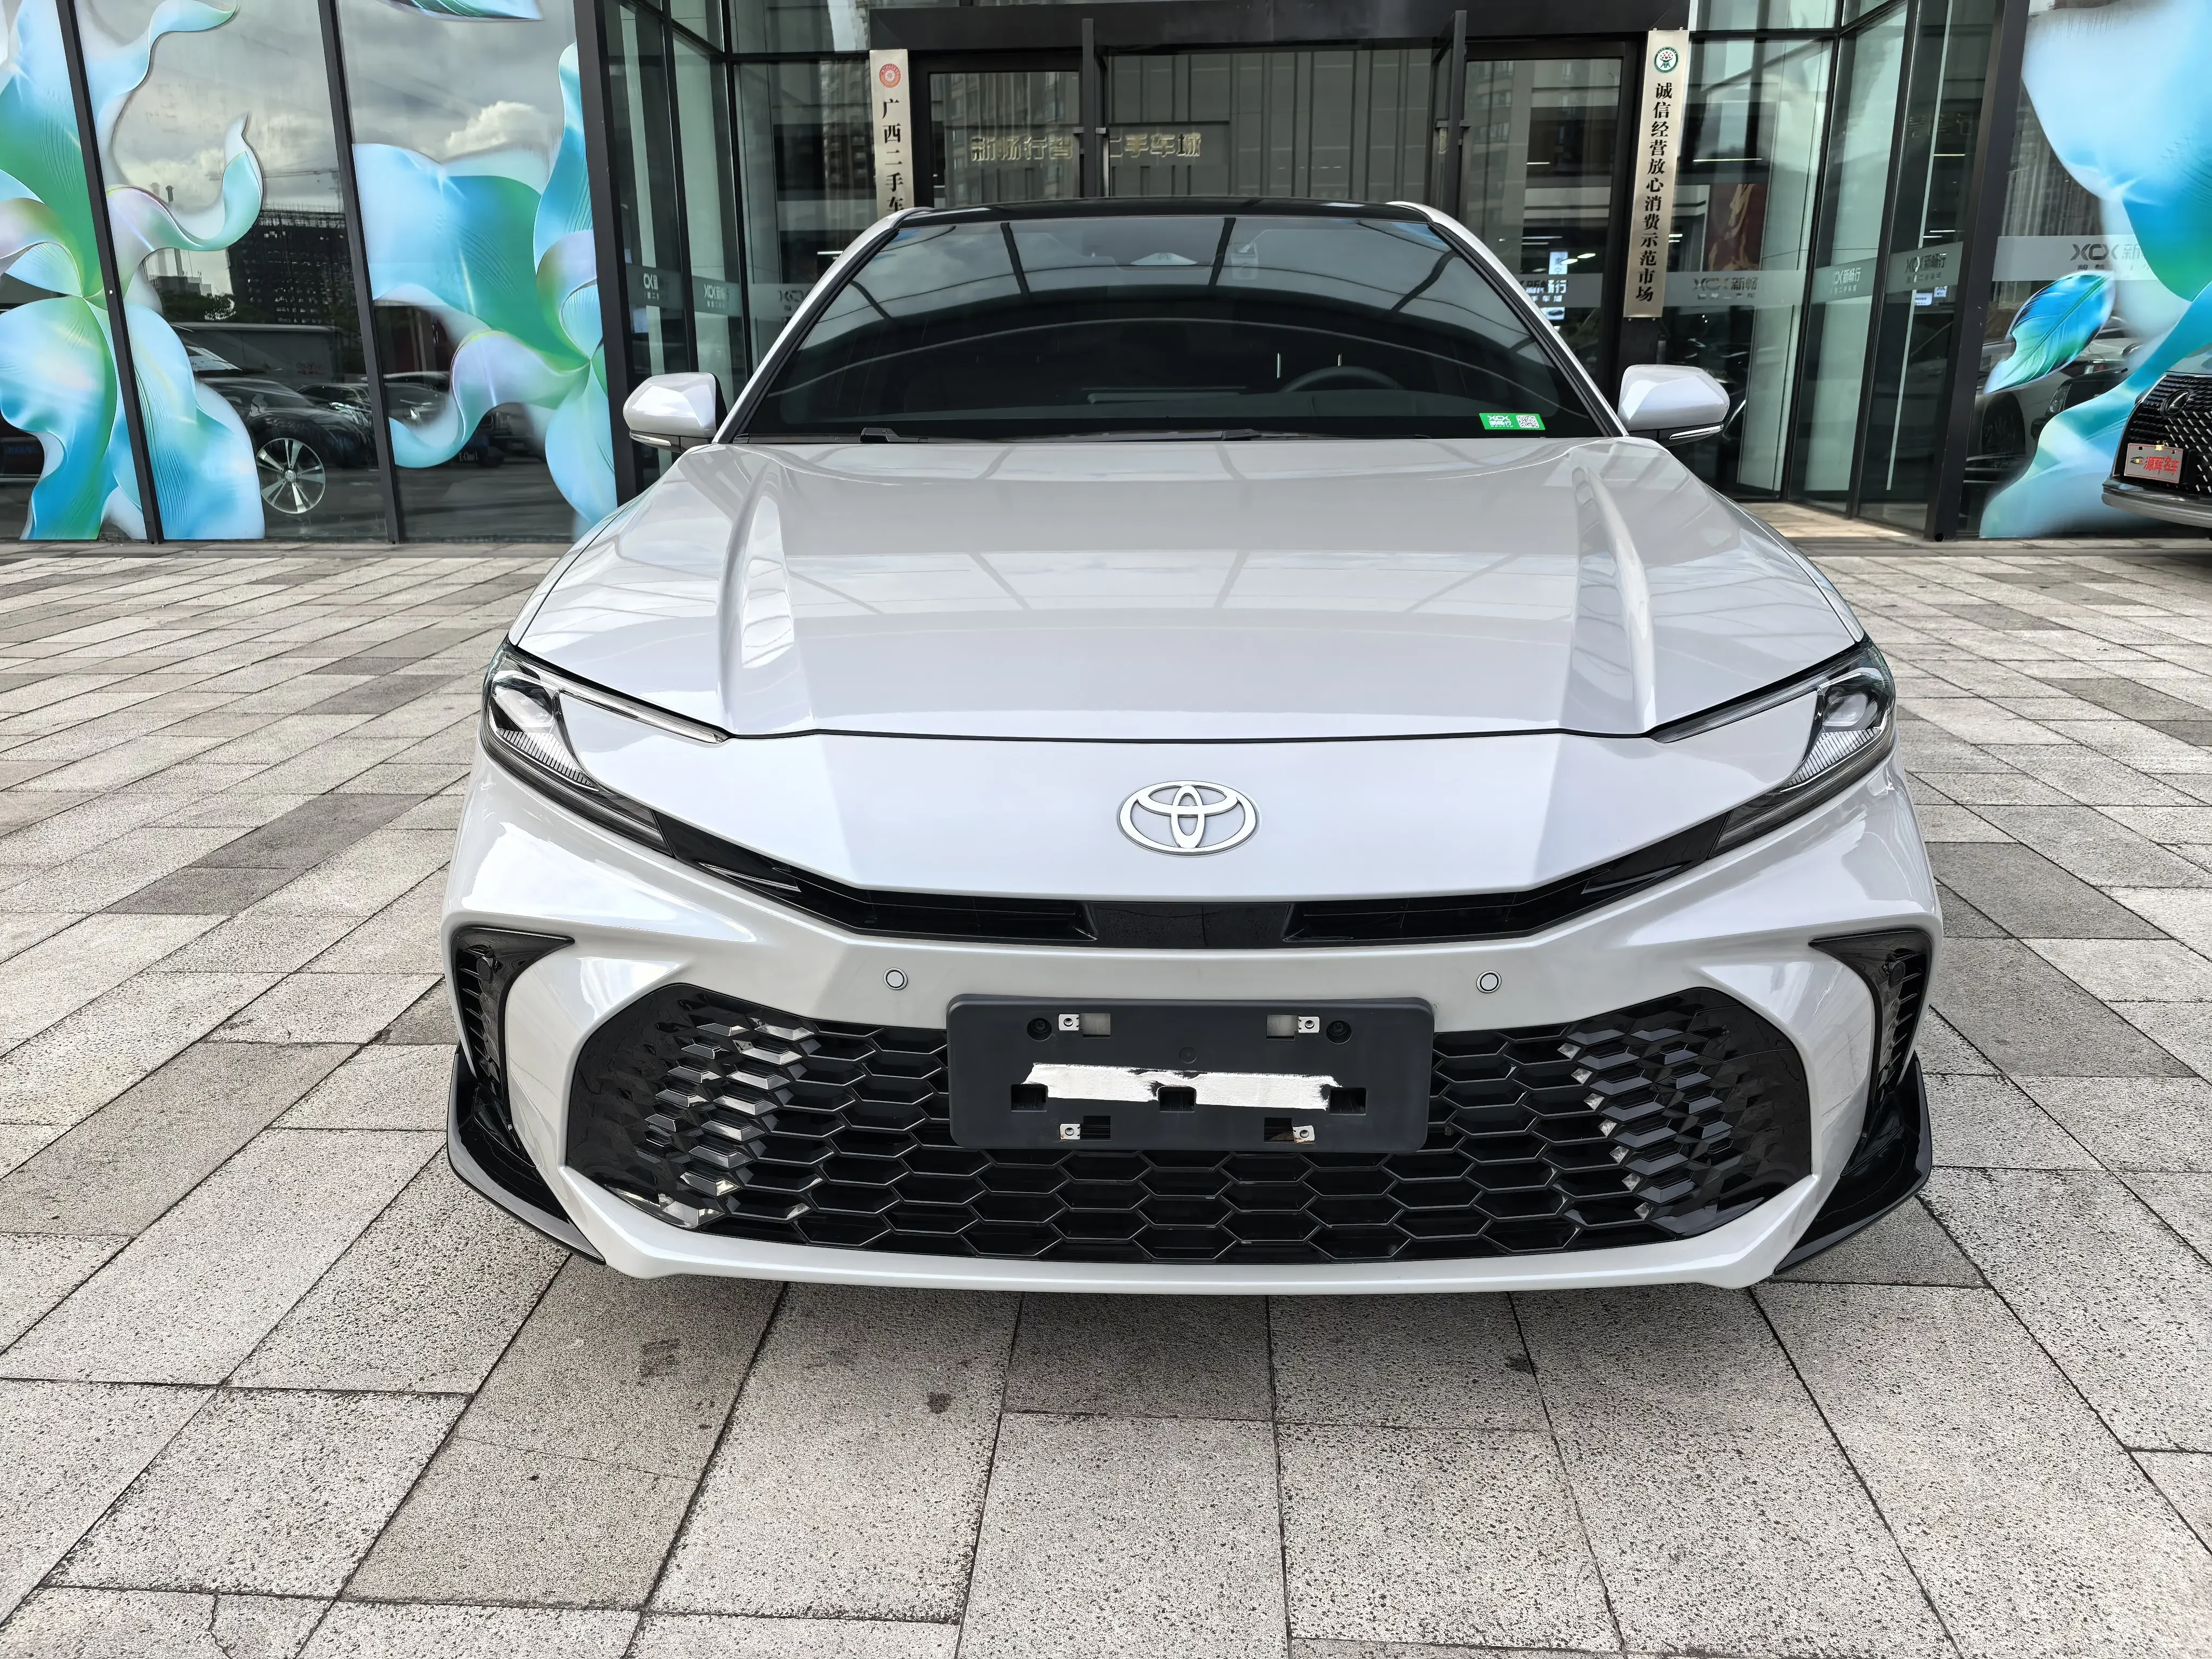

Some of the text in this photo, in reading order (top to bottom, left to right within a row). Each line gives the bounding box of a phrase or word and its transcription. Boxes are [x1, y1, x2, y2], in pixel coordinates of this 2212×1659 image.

[882, 98, 904, 212] 广西二手车
[1635, 82, 1673, 302] 诚信经营放心消费示范市场
